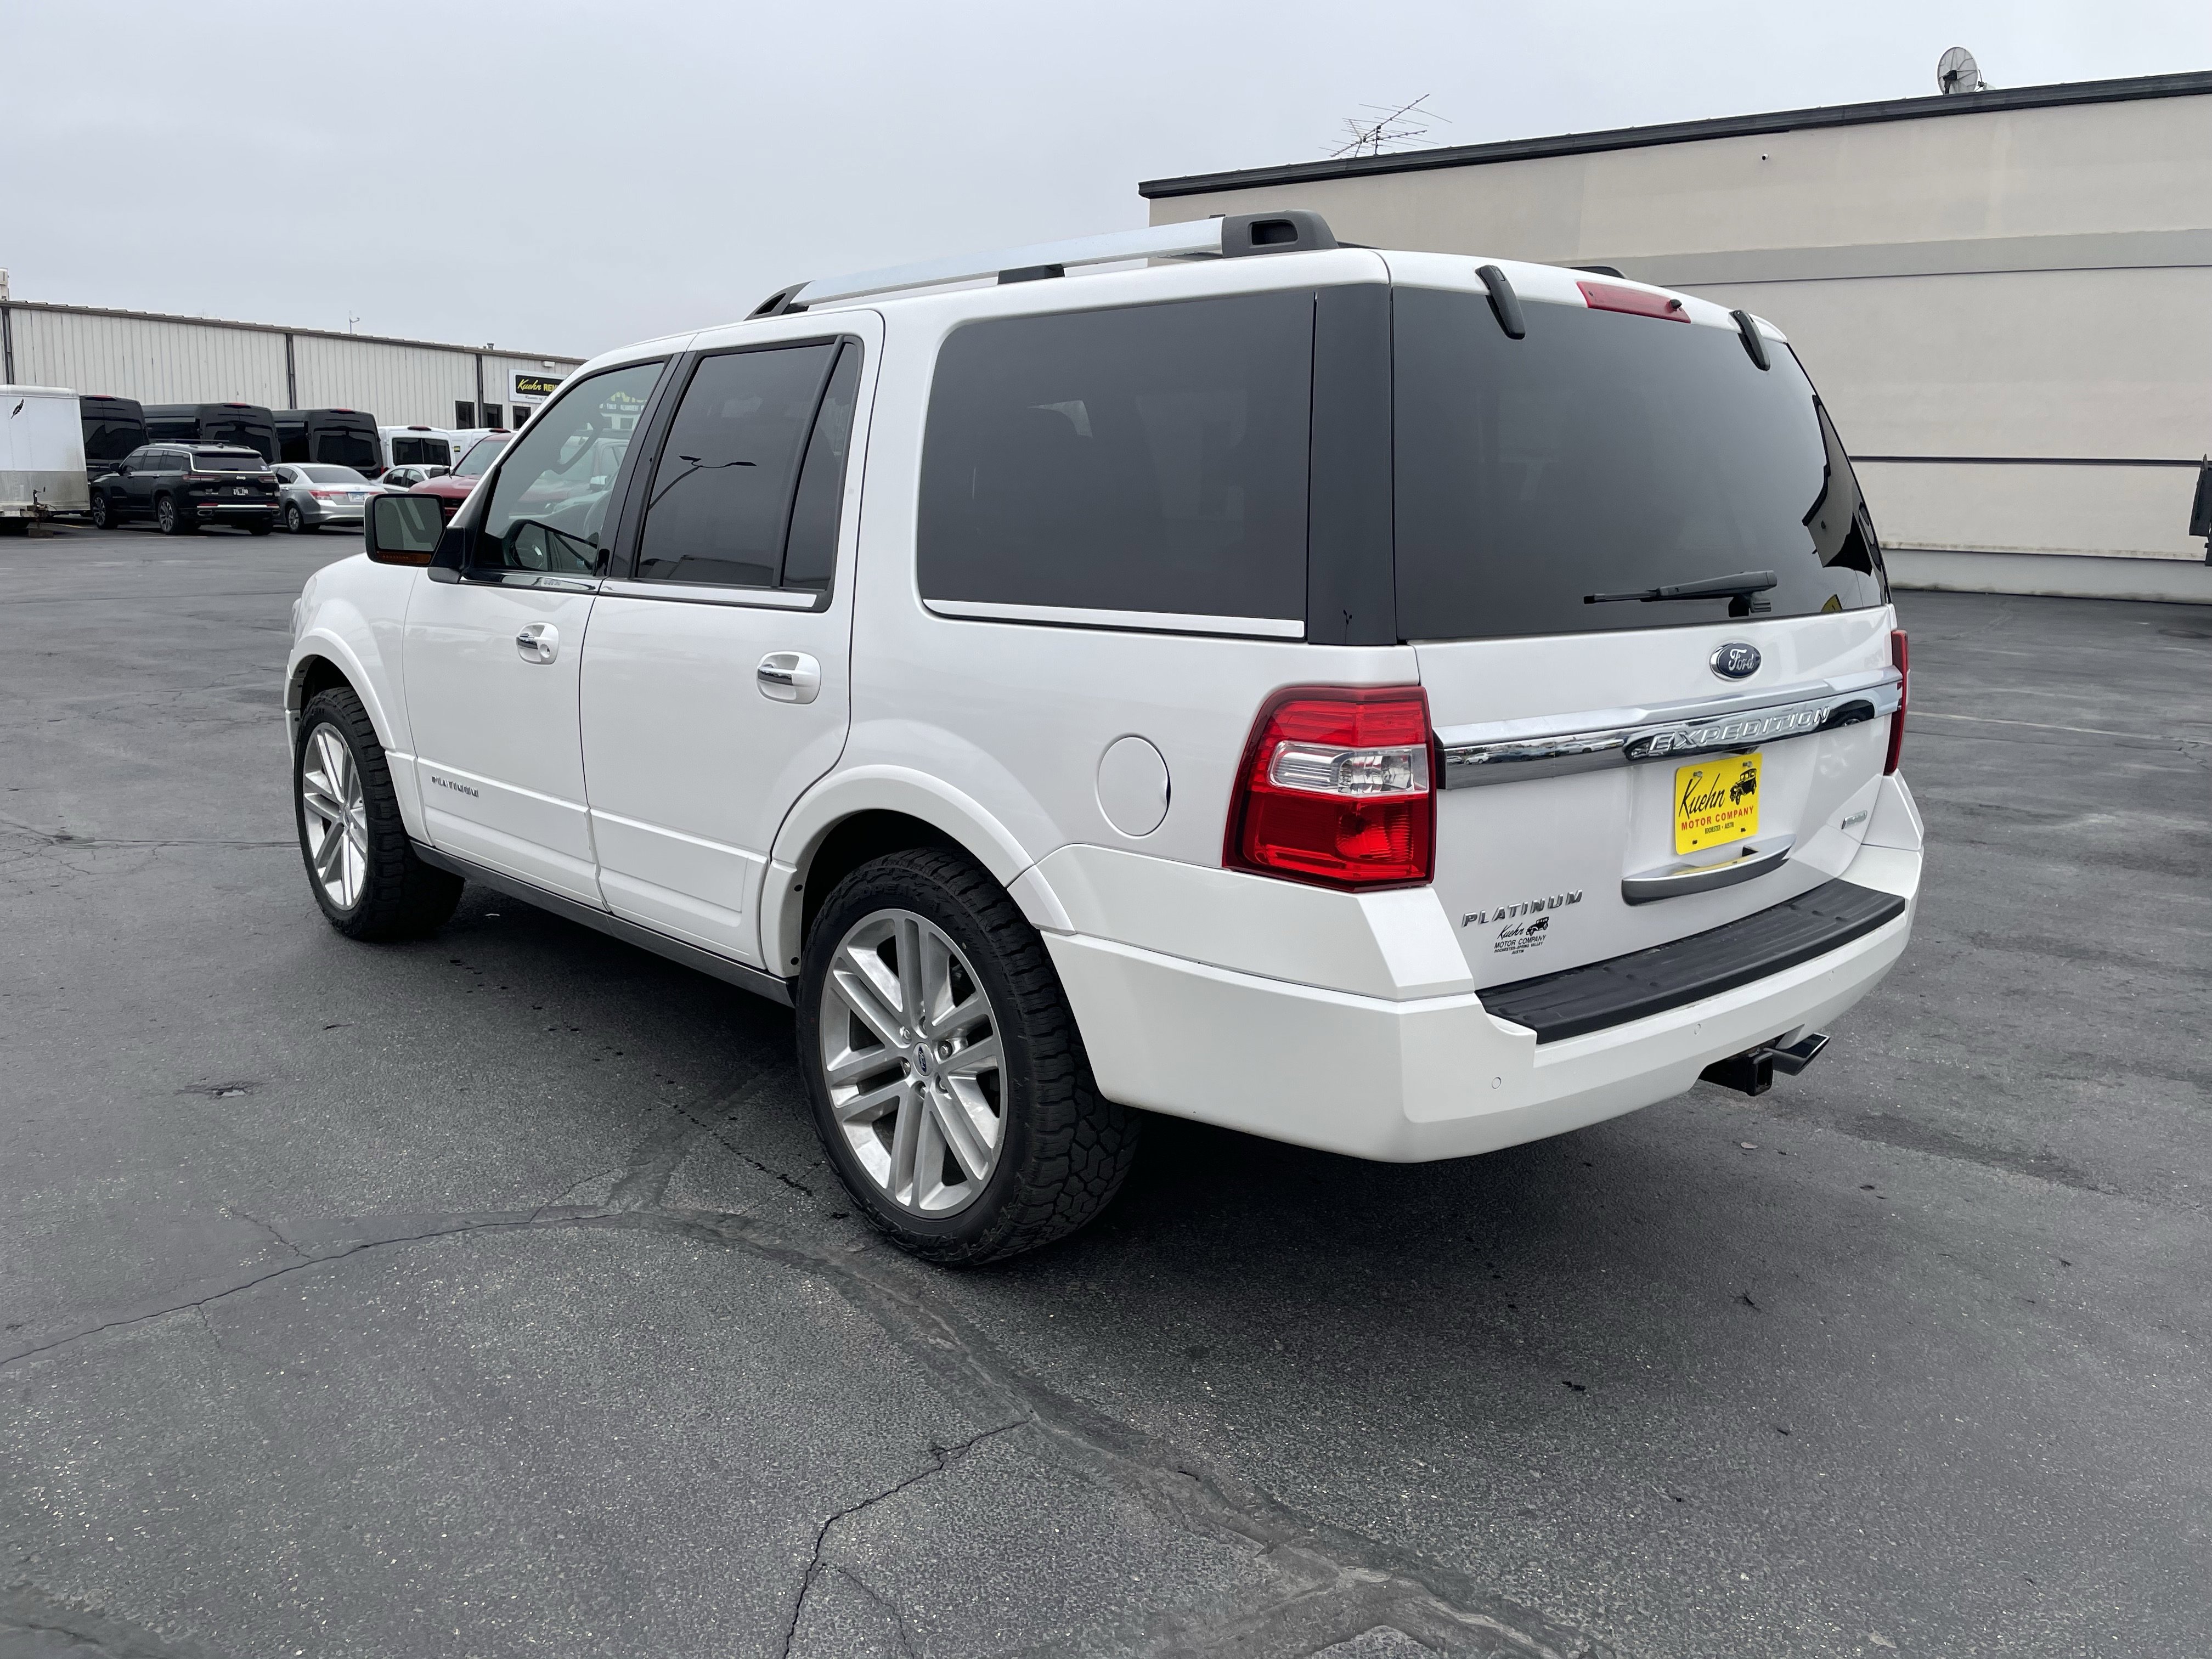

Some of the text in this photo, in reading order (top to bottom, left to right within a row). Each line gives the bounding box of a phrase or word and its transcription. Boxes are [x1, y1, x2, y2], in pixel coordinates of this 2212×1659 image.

[517, 379, 558, 392] Kuehn REN
[1729, 648, 1755, 671] Ford
[1647, 706, 1832, 756] EXPEDITION
[1678, 773, 1725, 820] Kuehn
[1681, 805, 1754, 831] MOTOR COMPANY
[1462, 889, 1583, 927] PLATINUM
[1494, 935, 1547, 949] MOTOR COMPANY
[1497, 922, 1524, 940] Kuehn
